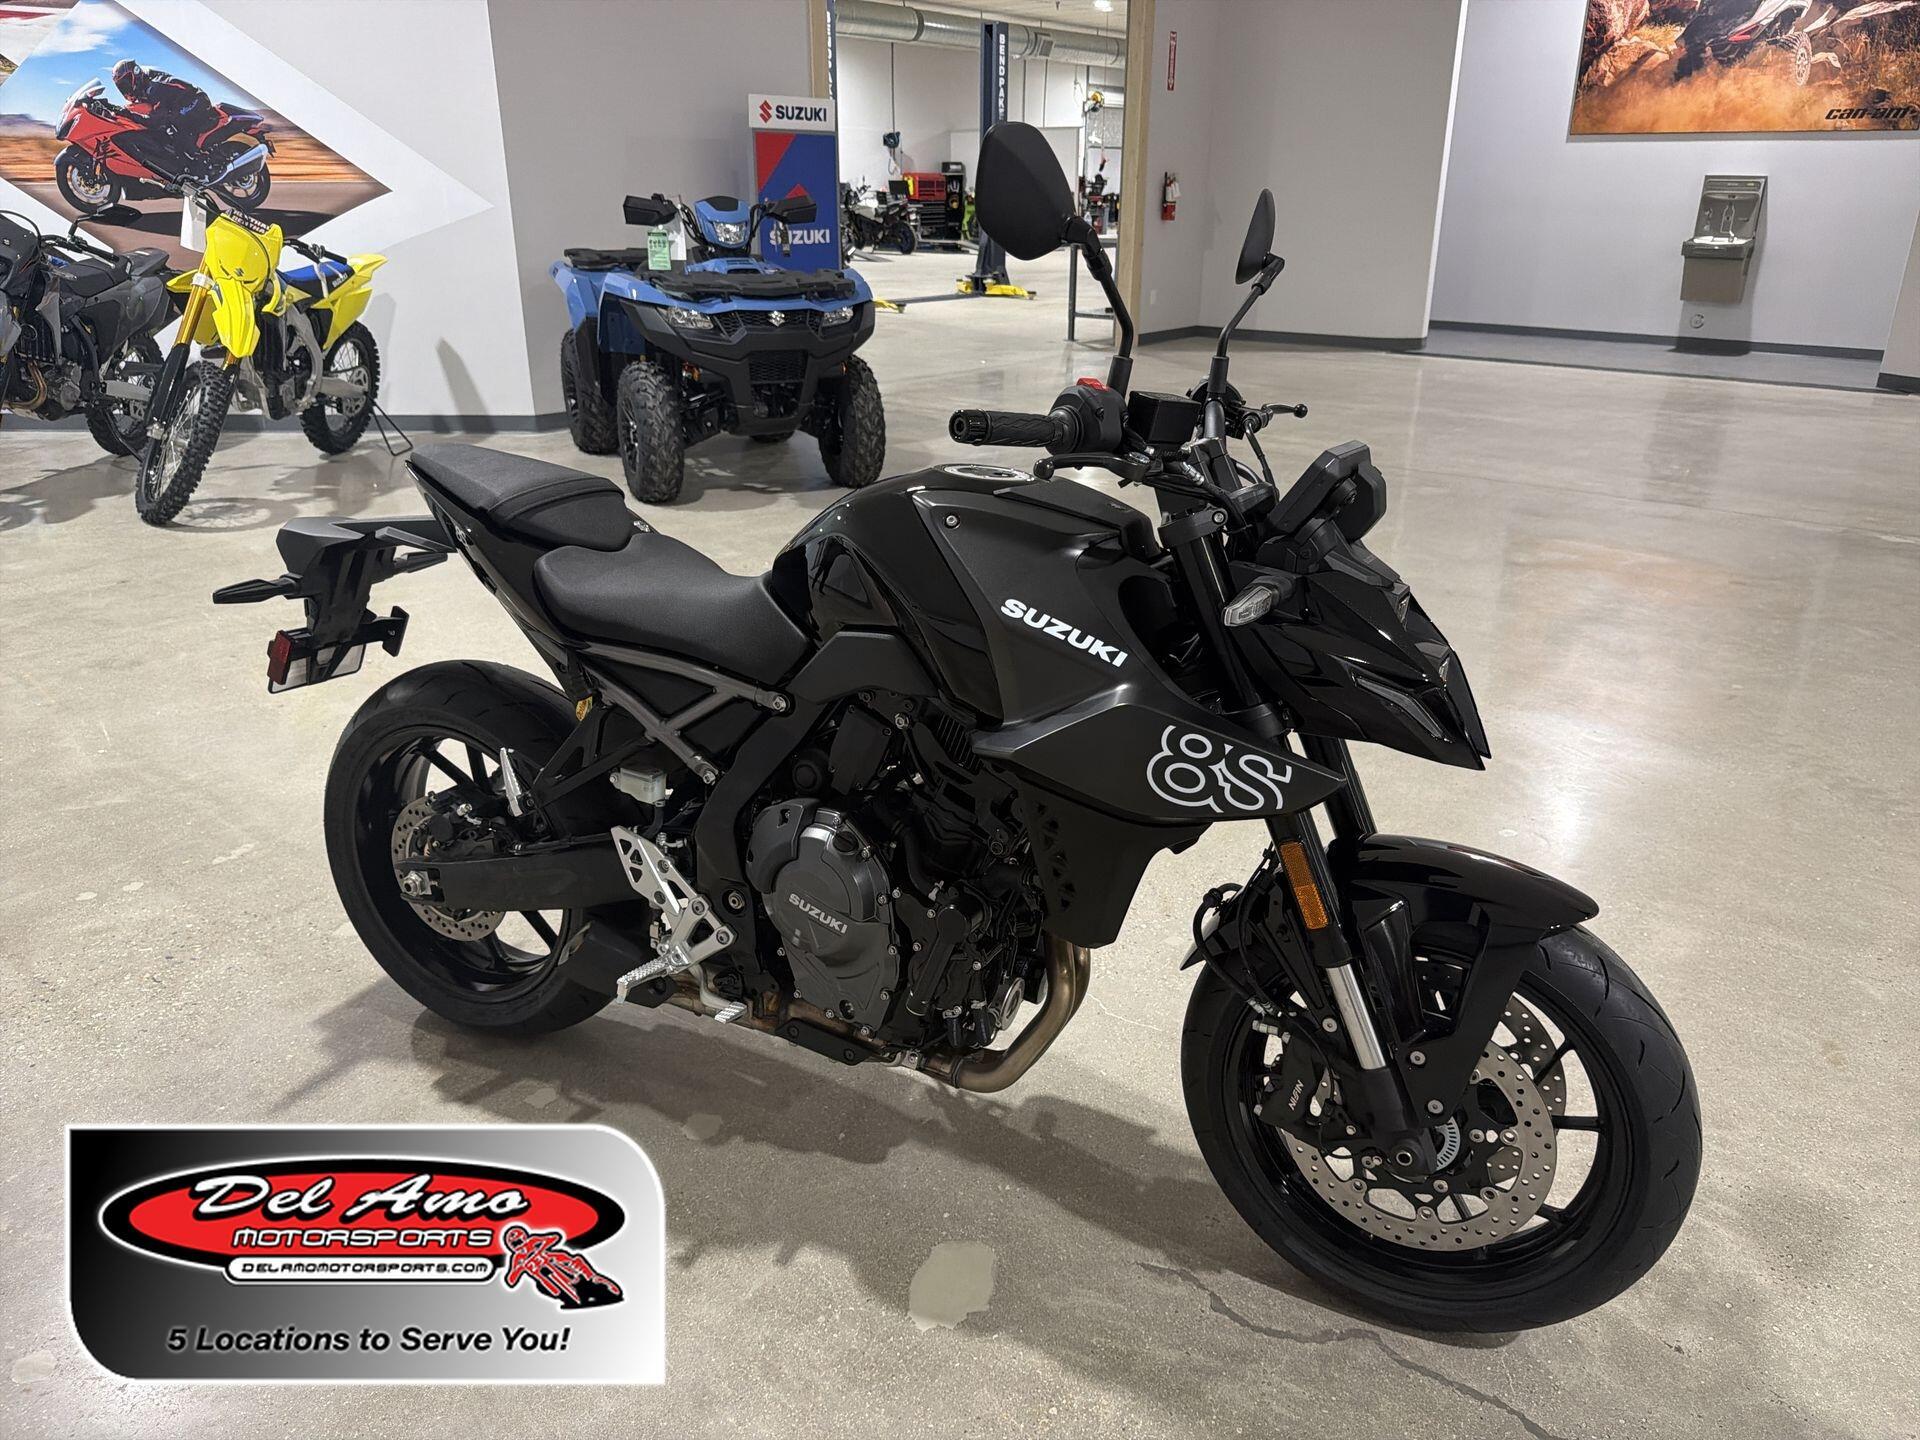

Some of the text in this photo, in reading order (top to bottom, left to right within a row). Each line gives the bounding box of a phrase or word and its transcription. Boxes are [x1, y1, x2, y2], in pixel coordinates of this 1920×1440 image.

[775, 105, 827, 122] SUZUKI
[1825, 106, 1914, 120] can-am
[1000, 598, 1129, 668] SUZUKI
[788, 893, 848, 933] SUZUKI
